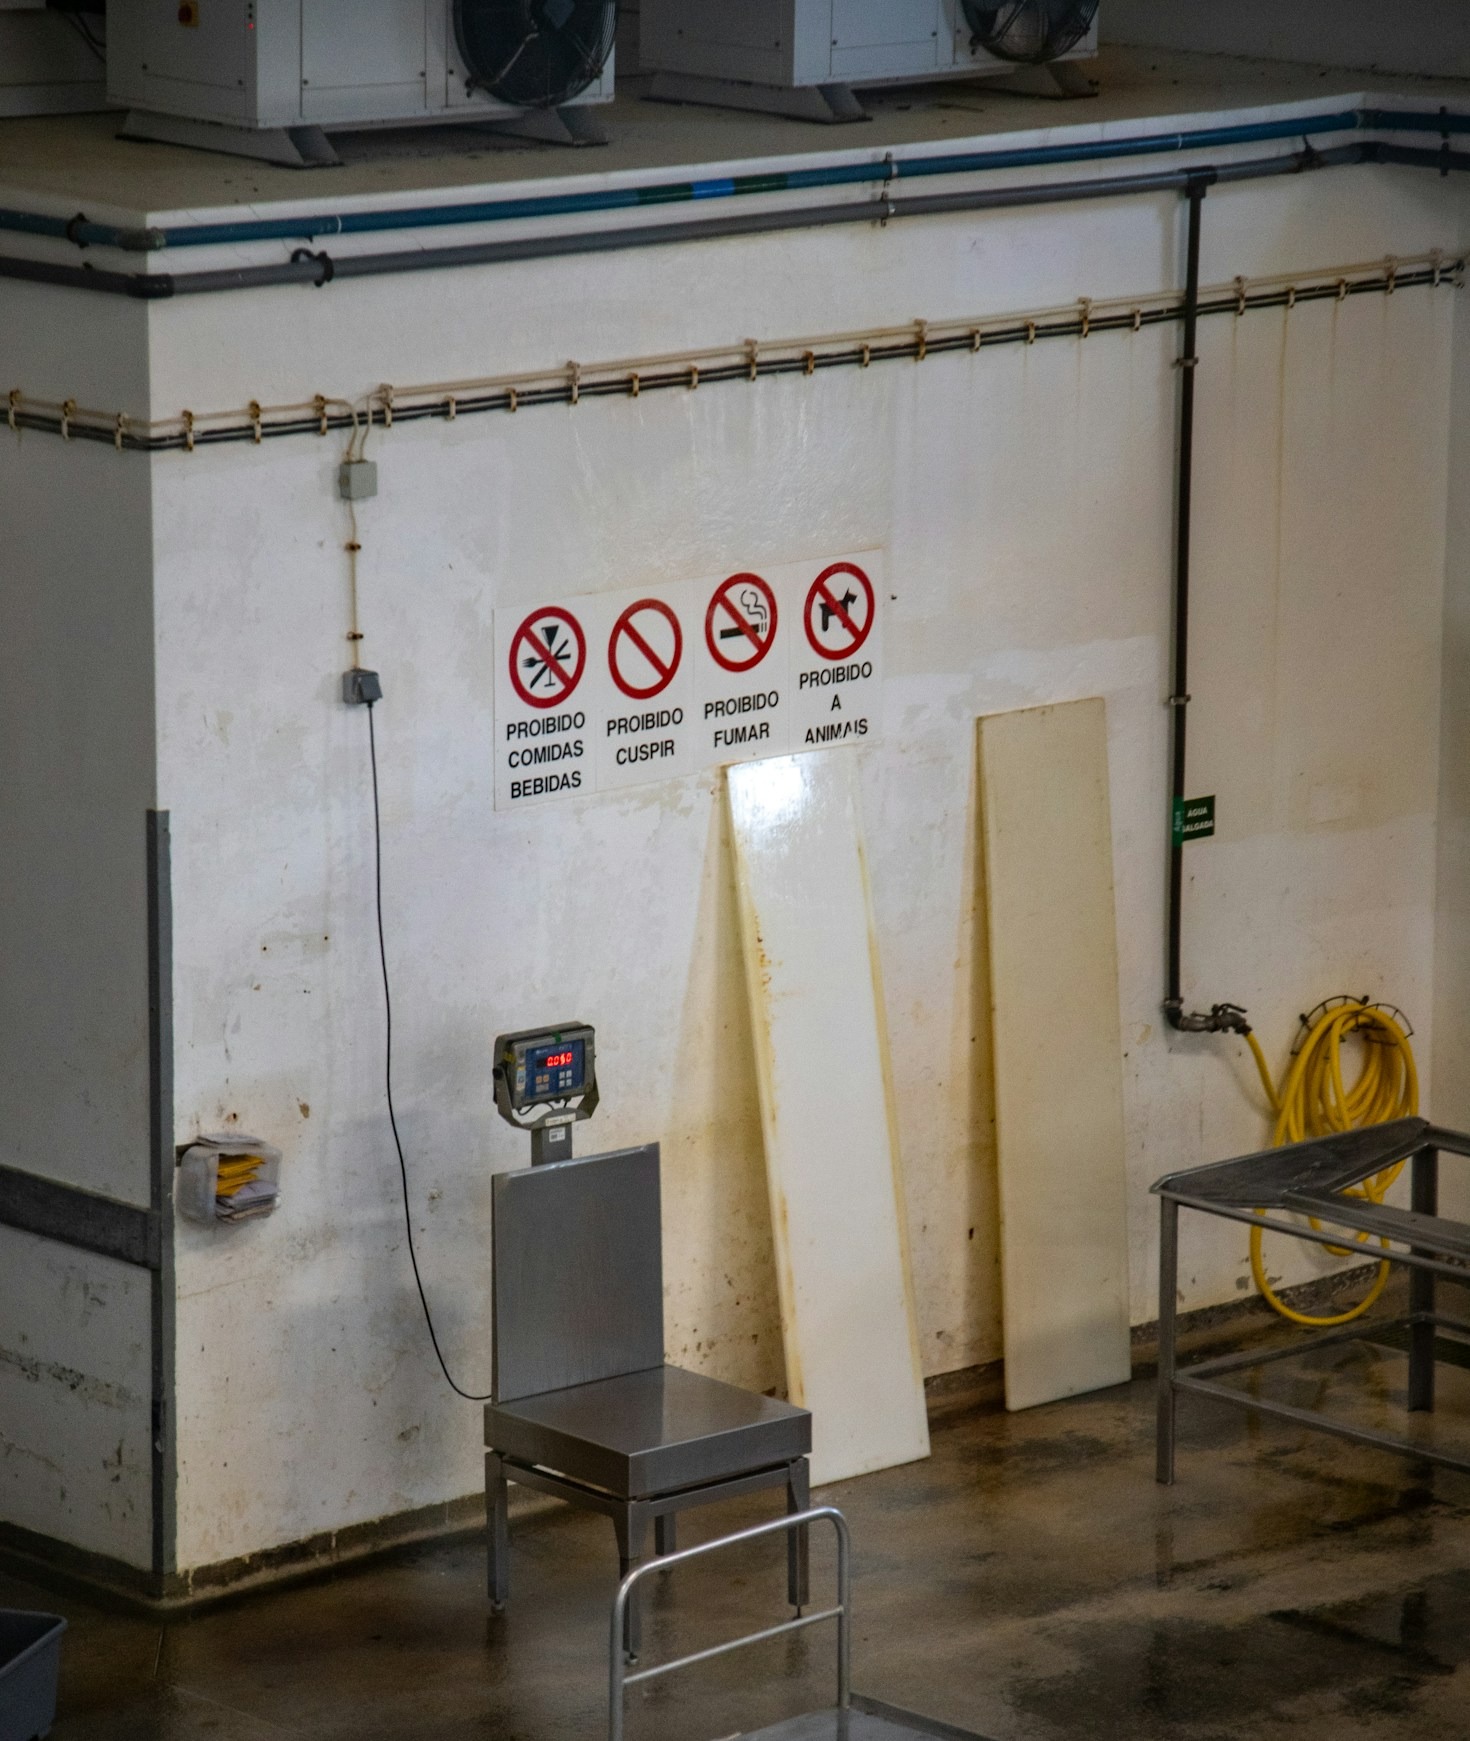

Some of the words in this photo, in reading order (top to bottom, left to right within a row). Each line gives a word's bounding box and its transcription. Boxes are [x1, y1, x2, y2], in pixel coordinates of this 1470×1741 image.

[799, 661, 872, 690] PROIBIDO
[704, 690, 779, 720] PROIBIDO
[830, 694, 842, 711] A
[507, 711, 586, 741] PROIBIDO
[607, 707, 683, 737] PROIBIDO
[714, 722, 770, 748] FUMAR
[805, 718, 868, 744] ANIMAIS
[508, 739, 584, 768] COMIDAS
[616, 739, 675, 765] CUSPIR
[511, 770, 581, 799] BEBIDAS
